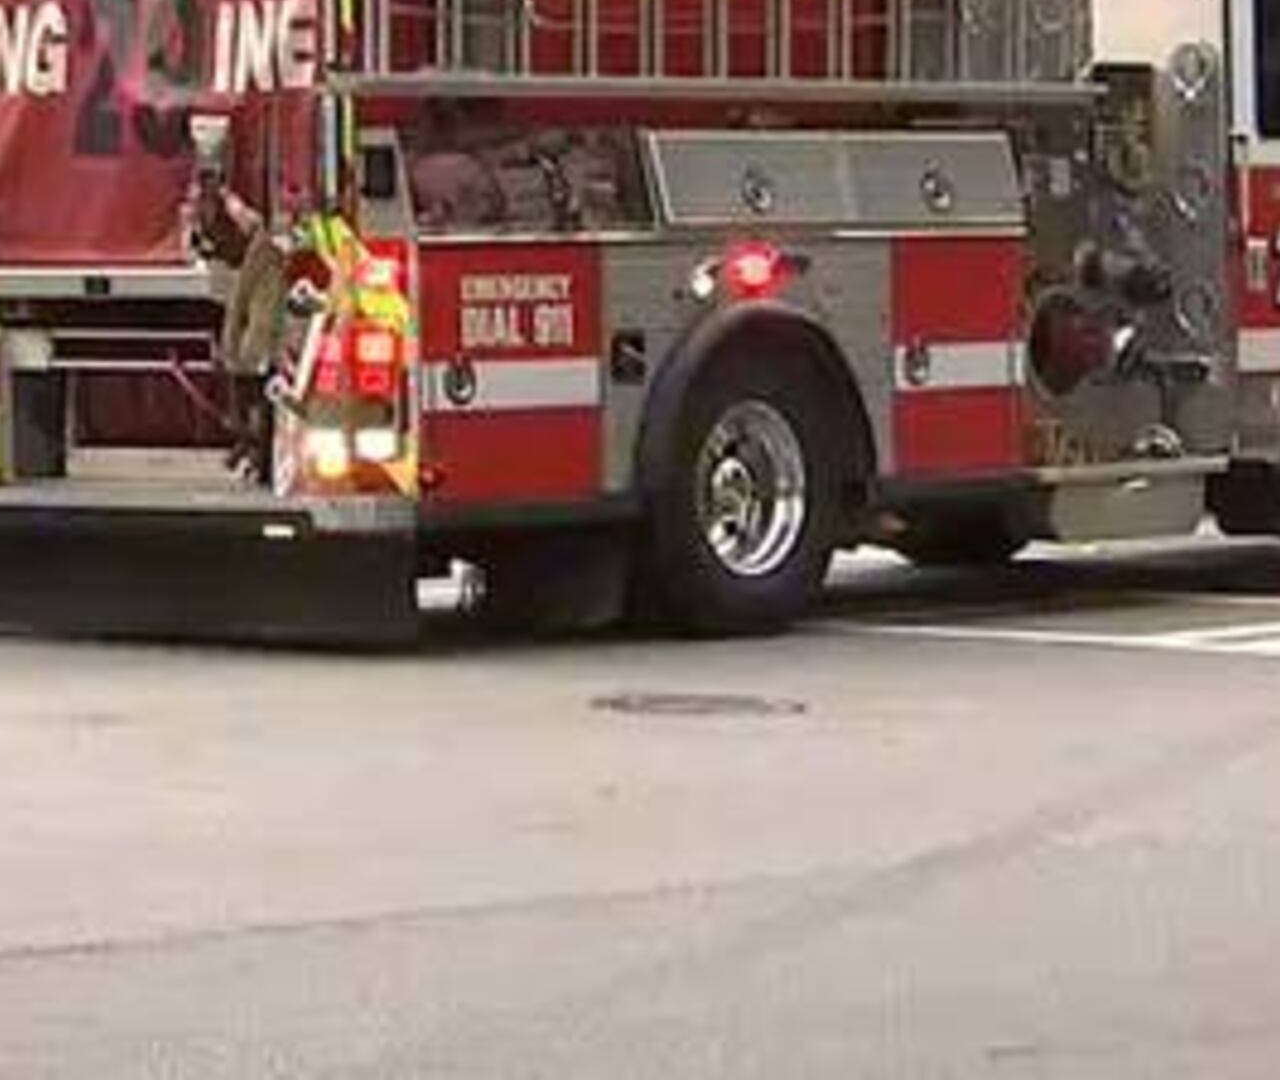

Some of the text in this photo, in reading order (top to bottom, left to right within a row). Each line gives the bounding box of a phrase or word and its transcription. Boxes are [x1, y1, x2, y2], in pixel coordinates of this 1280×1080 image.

[460, 274, 572, 300] EMERGENCY
[460, 302, 573, 348] DIAL 911
